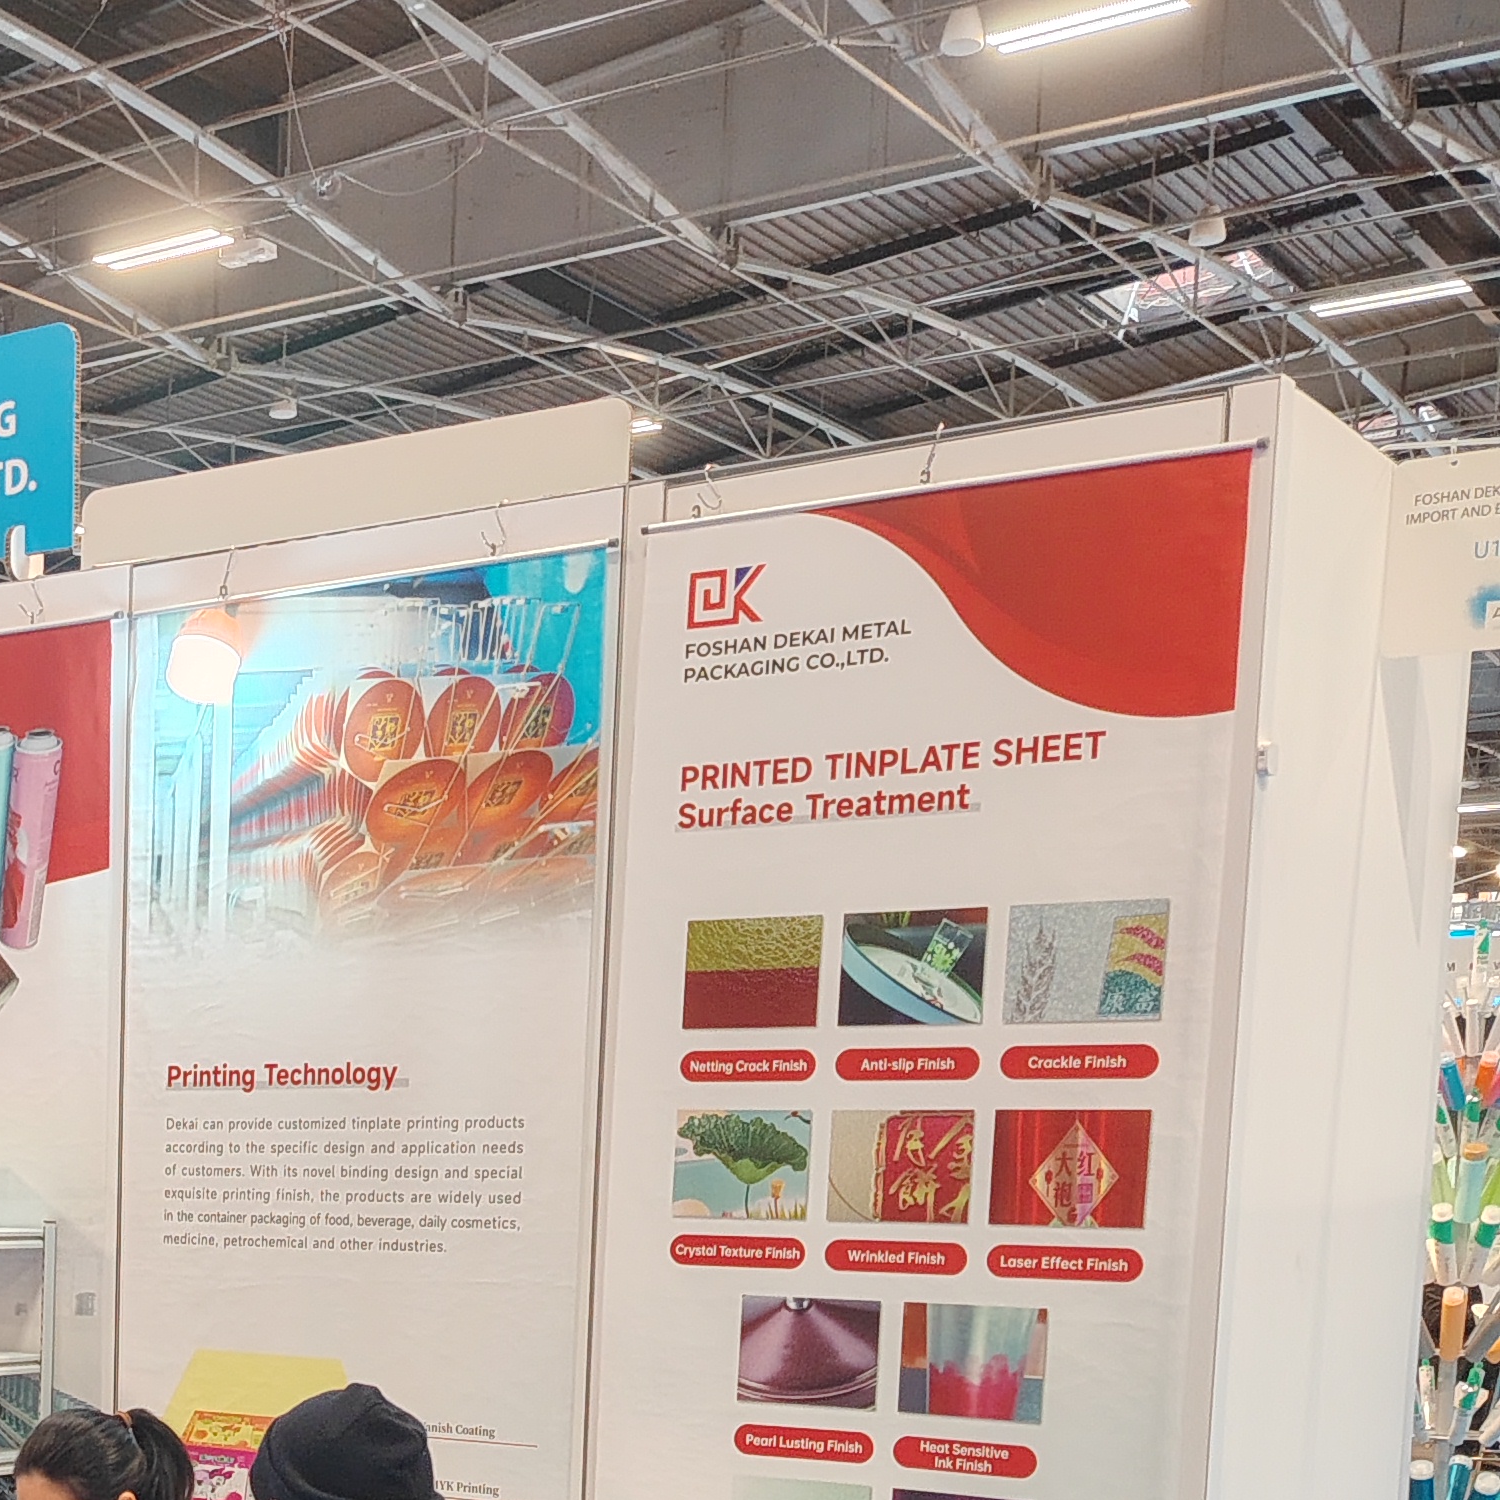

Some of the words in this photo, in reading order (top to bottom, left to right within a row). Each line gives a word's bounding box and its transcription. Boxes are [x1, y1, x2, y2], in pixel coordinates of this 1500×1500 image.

[1414, 489, 1471, 507] FOSHAN
[1406, 508, 1458, 525] IMPORT
[1461, 505, 1491, 518] AND
[685, 635, 767, 659] FOSHAN
[773, 628, 836, 650] DEKAI
[842, 619, 912, 643] METAL
[683, 658, 800, 683] PACKAGING
[806, 648, 889, 673] CO.,LTD.
[680, 755, 813, 792] PRINTED
[825, 741, 982, 782] TINPLATE
[992, 730, 1107, 767] SHEET
[677, 800, 793, 830] Surface
[806, 784, 970, 822] Treatment
[736, 1059, 769, 1072] Crack
[772, 1059, 807, 1072] Finish
[860, 1058, 914, 1073] Anti-slip
[917, 1057, 955, 1070] Finish
[1028, 1056, 1081, 1069] Crackle
[1084, 1056, 1127, 1069] Finish
[166, 1064, 256, 1092] Printing
[265, 1063, 398, 1090] Technology
[166, 1118, 198, 1131] Dekai
[202, 1119, 224, 1130] can
[228, 1118, 273, 1132] provide
[277, 1117, 347, 1130] customized
[351, 1116, 401, 1132] tinplate
[407, 1116, 459, 1132] printing
[464, 1116, 525, 1131] products
[165, 1141, 224, 1157] according
[229, 1142, 240, 1154] to
[245, 1141, 265, 1154] the
[270, 1141, 318, 1156] specific
[324, 1141, 365, 1156] design
[370, 1141, 395, 1154] and
[401, 1141, 476, 1157] application
[482, 1141, 524, 1155] needs
[164, 1164, 177, 1177] of
[181, 1165, 245, 1178] customers.
[250, 1164, 278, 1178] With
[283, 1165, 298, 1178] its
[302, 1165, 336, 1178] novel
[340, 1165, 389, 1182] binding
[394, 1166, 439, 1182] design
[444, 1166, 468, 1180] and
[474, 1166, 523, 1182] special
[164, 1187, 217, 1202] exquisite
[222, 1187, 270, 1204] printing
[276, 1188, 314, 1204] finish,
[320, 1189, 340, 1203] the
[345, 1190, 404, 1205] products
[410, 1192, 432, 1204] are
[438, 1191, 482, 1207] widely
[488, 1191, 522, 1205] used
[164, 1209, 173, 1222] in
[177, 1210, 193, 1223] the
[197, 1212, 247, 1224] container
[250, 1212, 305, 1228] packaging
[309, 1213, 320, 1226] of
[325, 1213, 353, 1228] food,
[357, 1214, 414, 1231] beverage,
[419, 1215, 446, 1231] daily
[451, 1216, 521, 1232] cosmetics,
[163, 1234, 219, 1248] medicine,
[223, 1235, 308, 1251] petrochemical
[313, 1238, 334, 1250] and
[340, 1238, 373, 1251] other
[378, 1239, 447, 1253] industries.
[675, 1244, 717, 1258] Crystal
[719, 1246, 763, 1258] Texture
[765, 1247, 800, 1259] Finish
[848, 1250, 905, 1264] Wrinkled
[908, 1252, 945, 1265] Finish
[1000, 1255, 1038, 1268] Laser
[1041, 1257, 1083, 1270] Effect
[1087, 1258, 1128, 1272] Finish
[424, 1422, 453, 1433] anish
[456, 1425, 495, 1440] Coating
[746, 1434, 777, 1447] Pearl
[779, 1436, 824, 1452] Lusting
[827, 1440, 862, 1454] Finish
[920, 1440, 950, 1454] Heat
[952, 1444, 1009, 1460] Sensitive
[934, 1457, 953, 1469] Ink
[956, 1459, 992, 1472] Finish
[457, 1482, 499, 1498] Printing
